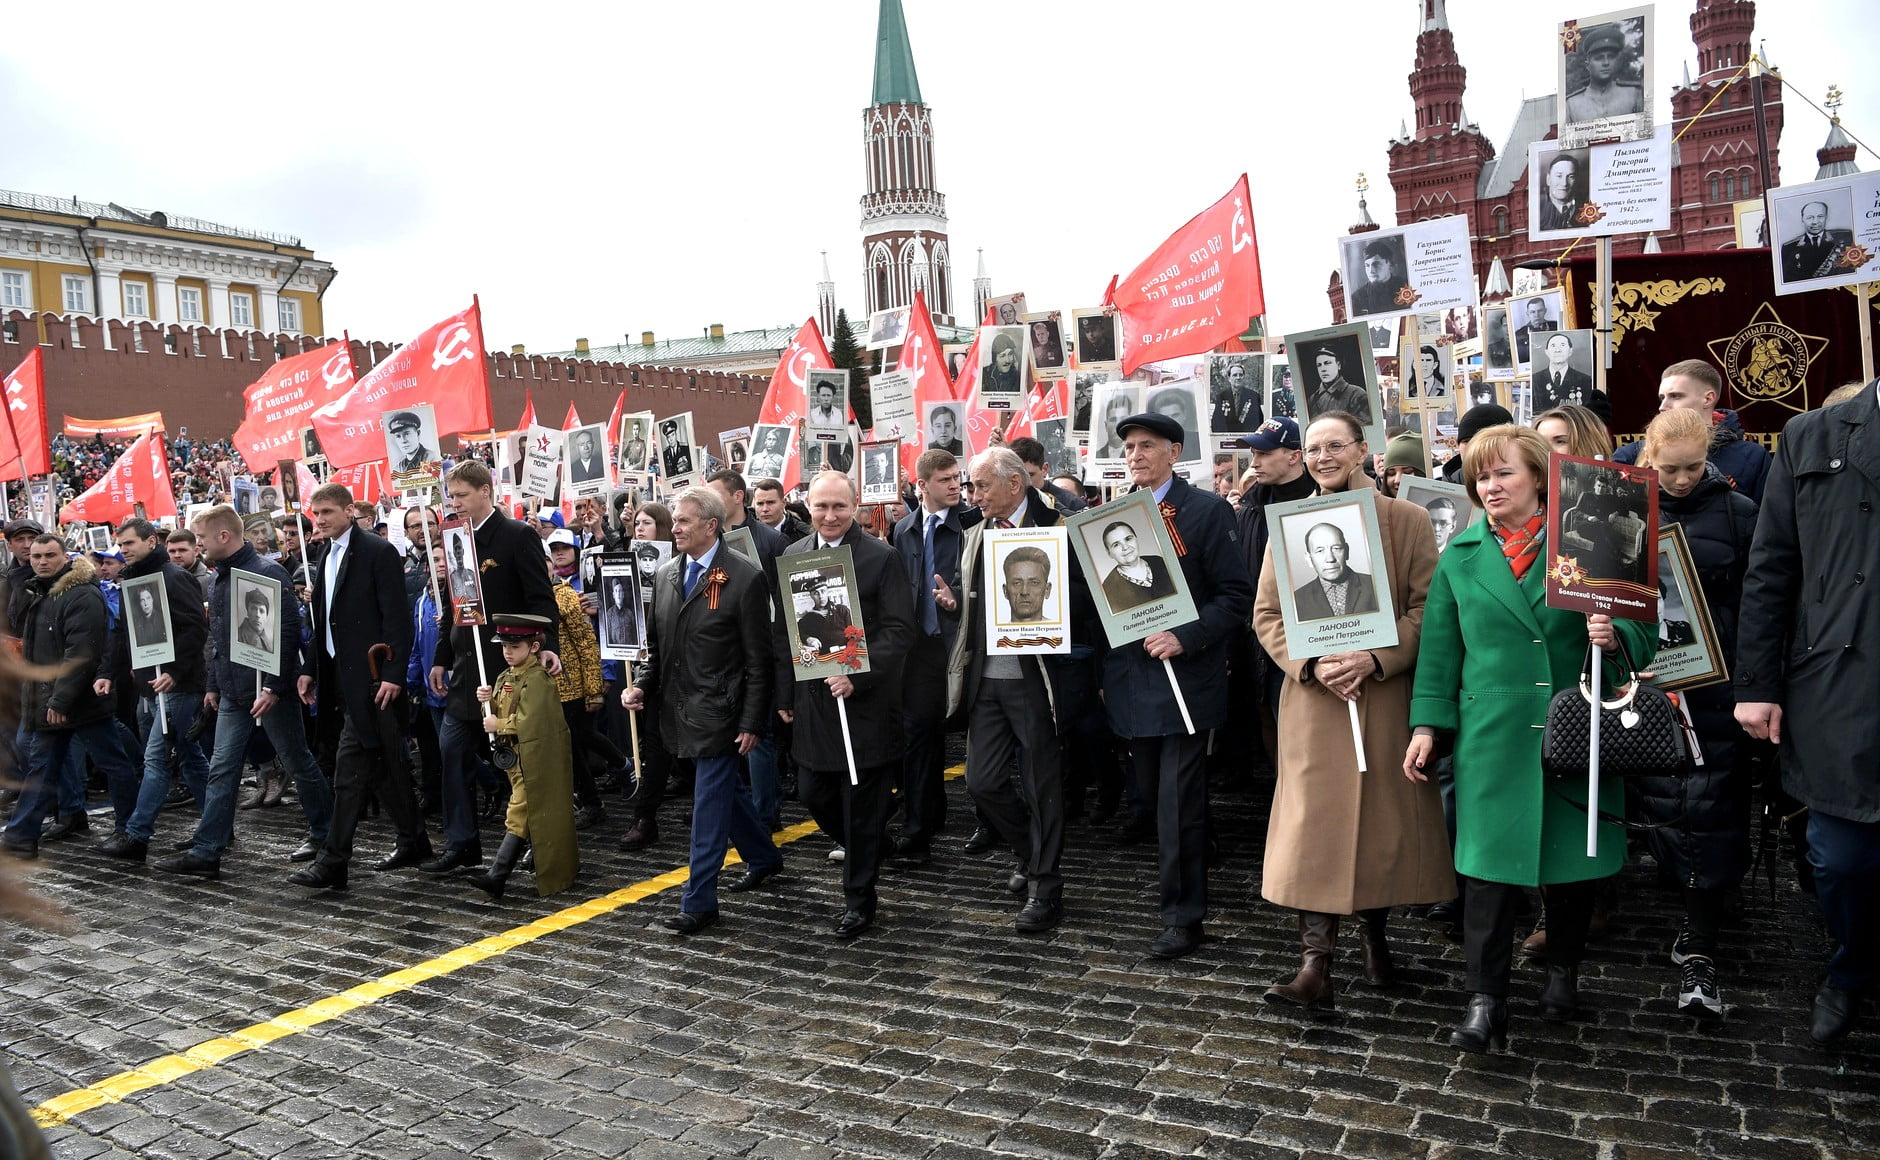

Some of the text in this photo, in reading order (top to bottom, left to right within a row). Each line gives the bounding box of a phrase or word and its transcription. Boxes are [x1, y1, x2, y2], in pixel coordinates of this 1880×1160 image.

[1614, 147, 1650, 157] Пыльнов
[1612, 156, 1649, 168] Григорий
[1604, 166, 1656, 178] Дмитриевич
[1619, 205, 1634, 213] 1942
[1416, 238, 1452, 249] Галушкин
[1424, 247, 1446, 257] Борис
[1412, 253, 1462, 266] Лаврентьевич
[1727, 324, 1806, 379] БЕССМЕРТНЫЙ ПОЛК РОССИИ
[1591, 593, 1613, 603] Степан
[1614, 597, 1646, 608] Ананьевич
[1595, 602, 1611, 610] 1942
[1131, 604, 1164, 620] ЛАНОВАЯ
[1123, 608, 1178, 632] Галина Ивановна
[1319, 620, 1360, 632] ЛАНОВОЙ
[1308, 629, 1374, 643] Семен Петрович
[1649, 652, 1687, 665] ИХАЙЛОВА
[1669, 655, 1703, 667] Наумовна
